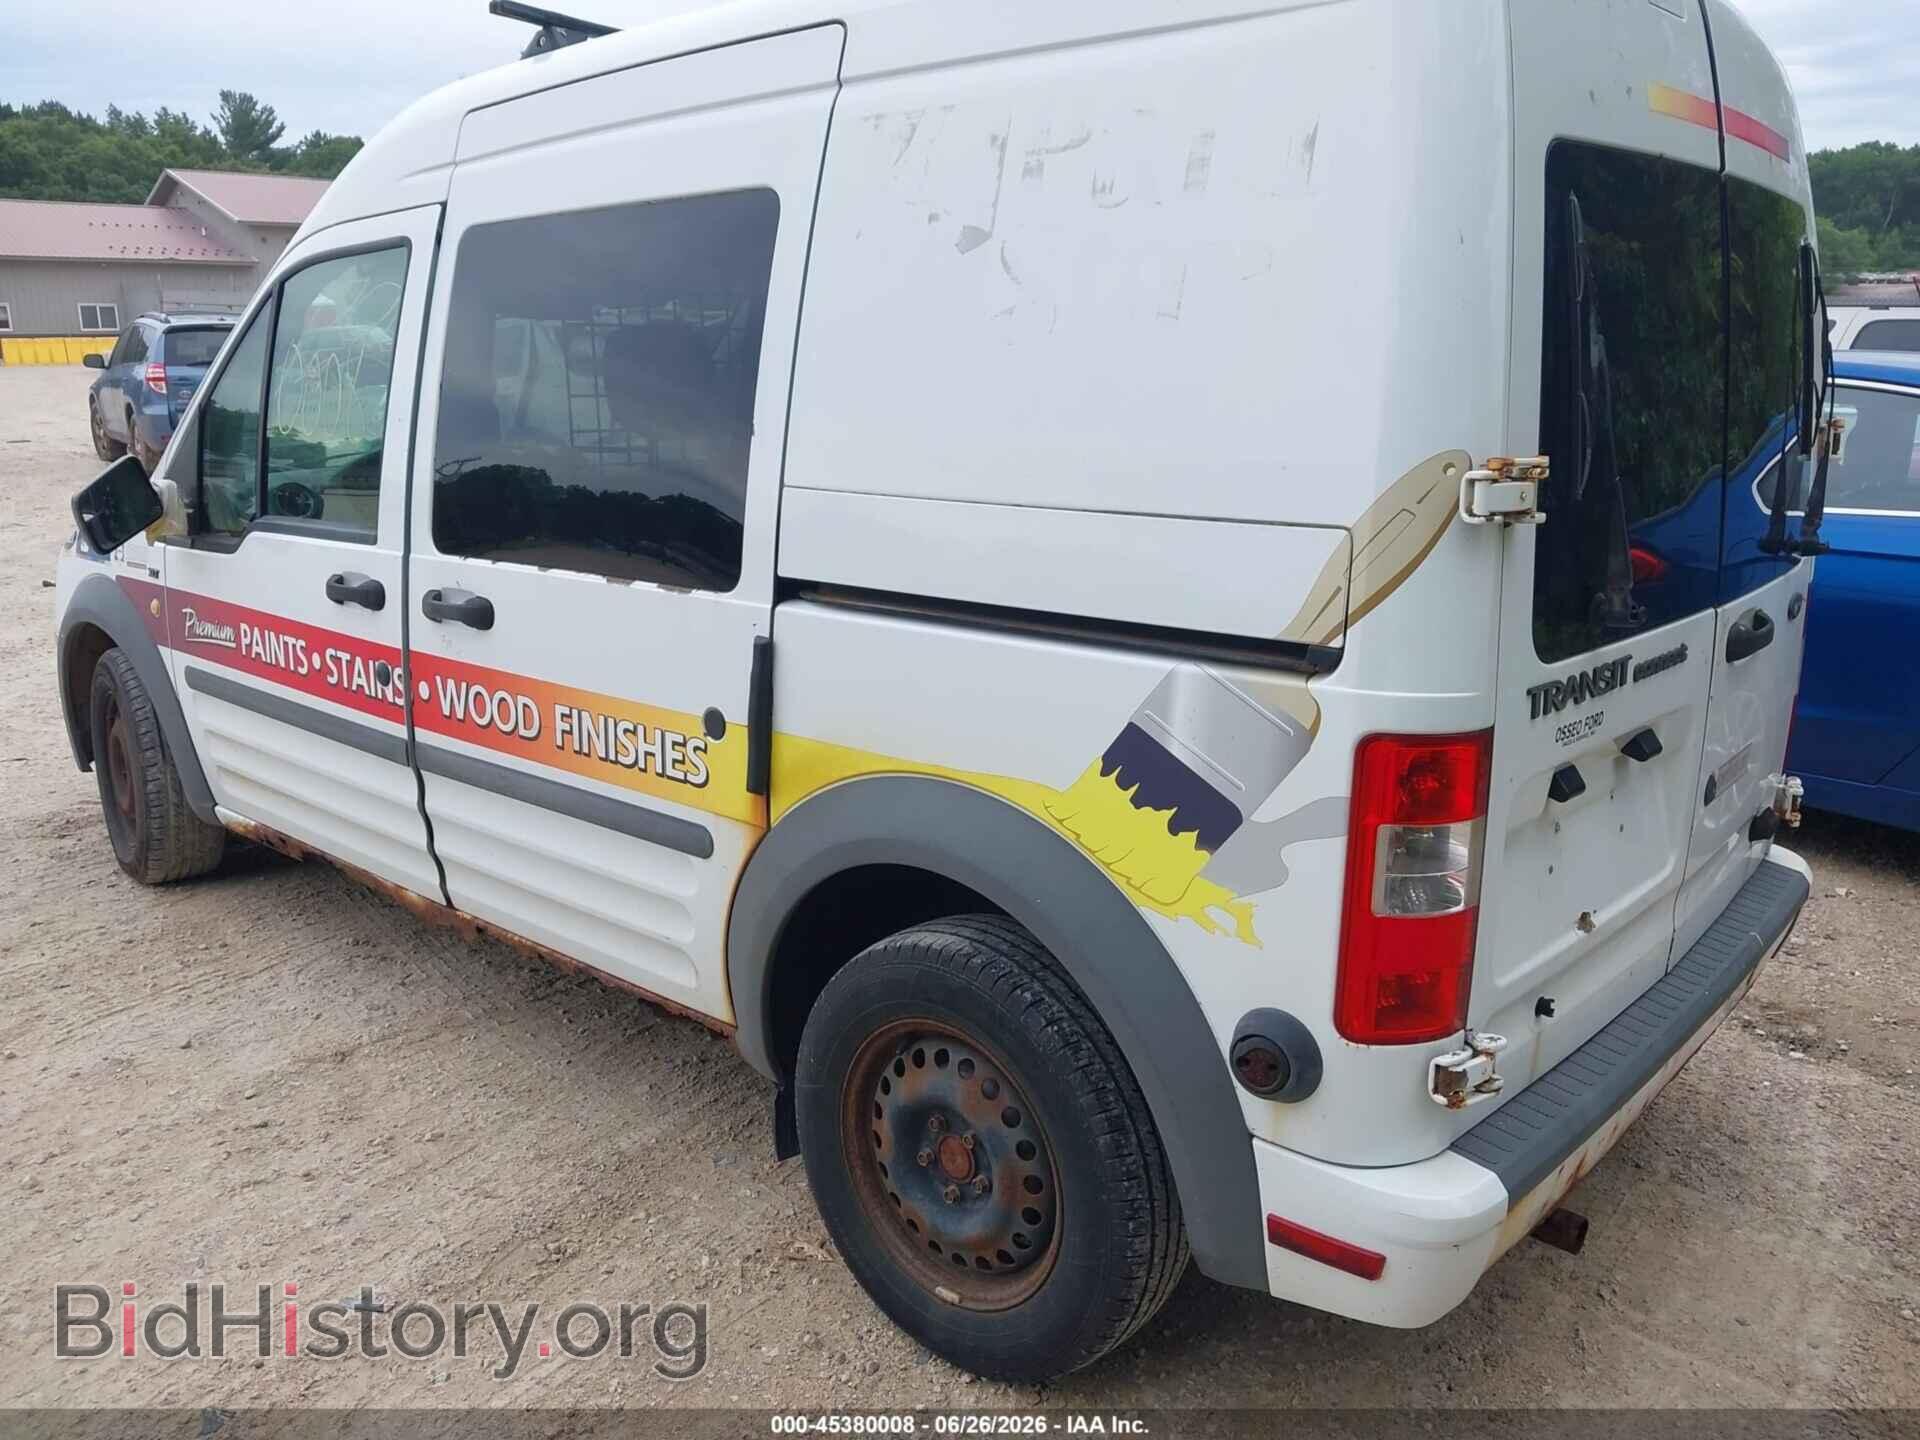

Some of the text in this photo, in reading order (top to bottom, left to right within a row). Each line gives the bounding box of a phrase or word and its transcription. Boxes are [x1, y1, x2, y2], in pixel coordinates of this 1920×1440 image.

[181, 608, 237, 643] Premium
[240, 622, 309, 676] PAINTS
[435, 674, 541, 740] WOOD
[554, 703, 709, 788] FINISHES
[1526, 654, 1633, 720] TRANSIT
[1583, 710, 1605, 733] FORD
